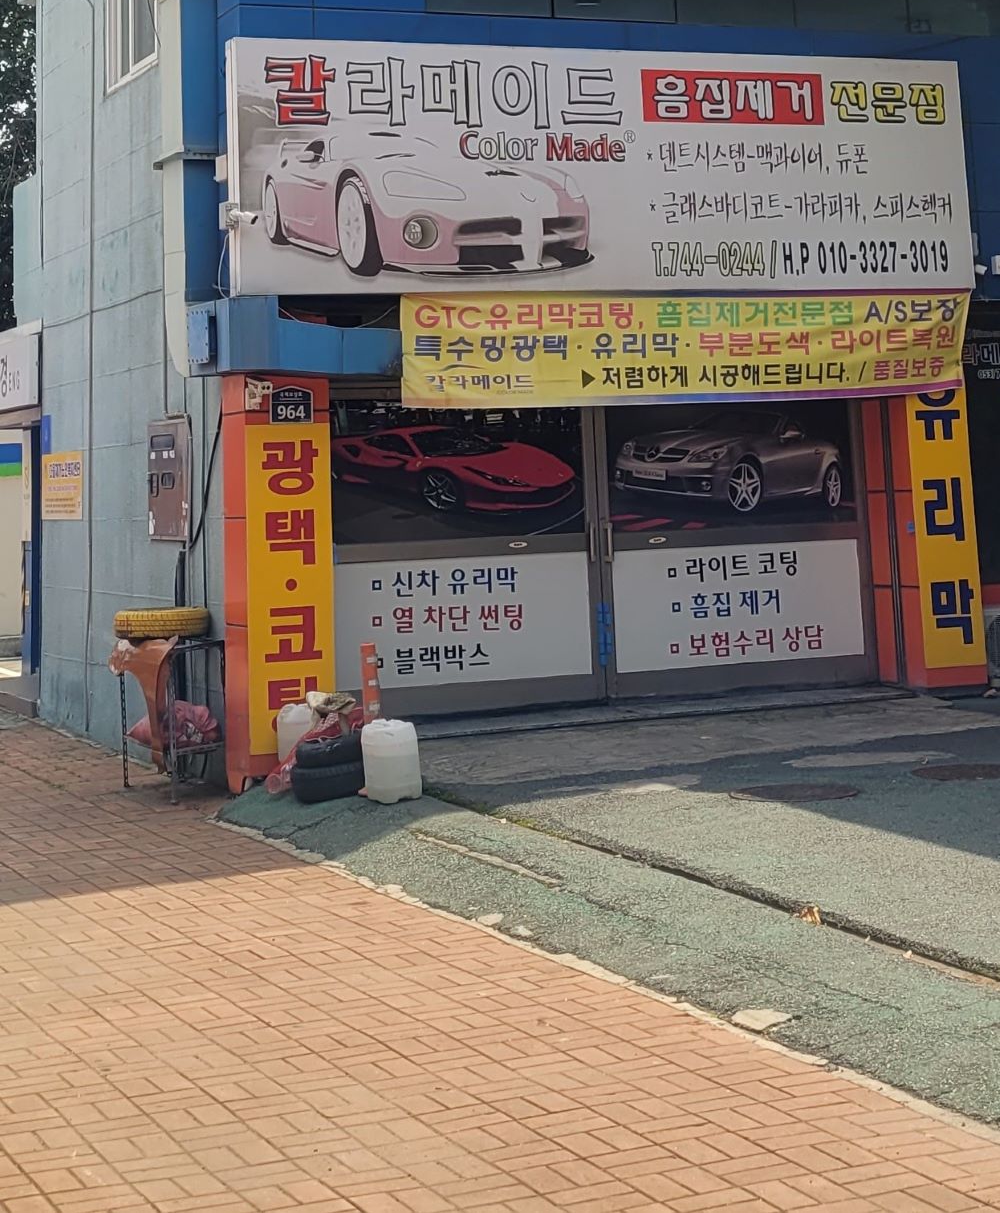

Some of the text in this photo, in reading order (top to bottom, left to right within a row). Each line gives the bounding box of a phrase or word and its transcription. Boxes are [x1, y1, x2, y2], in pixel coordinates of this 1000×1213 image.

[264, 54, 623, 129] 칼라메이드
[830, 80, 946, 124] 전문점
[459, 131, 538, 161] Color
[836, 143, 868, 174] 듀폰
[818, 240, 949, 274] 010-3327-3019
[864, 298, 960, 325] A/S보장
[873, 357, 945, 381] 품질보증
[277, 405, 306, 420] 964
[392, 566, 518, 597] 신차 유리막
[685, 551, 798, 582] 라이트 코팅
[392, 603, 523, 634] 열 차단 썬팅
[690, 588, 781, 618] 흠집 제거
[688, 624, 824, 657] 보험수리 상담
[394, 643, 490, 674] 블랙박스
